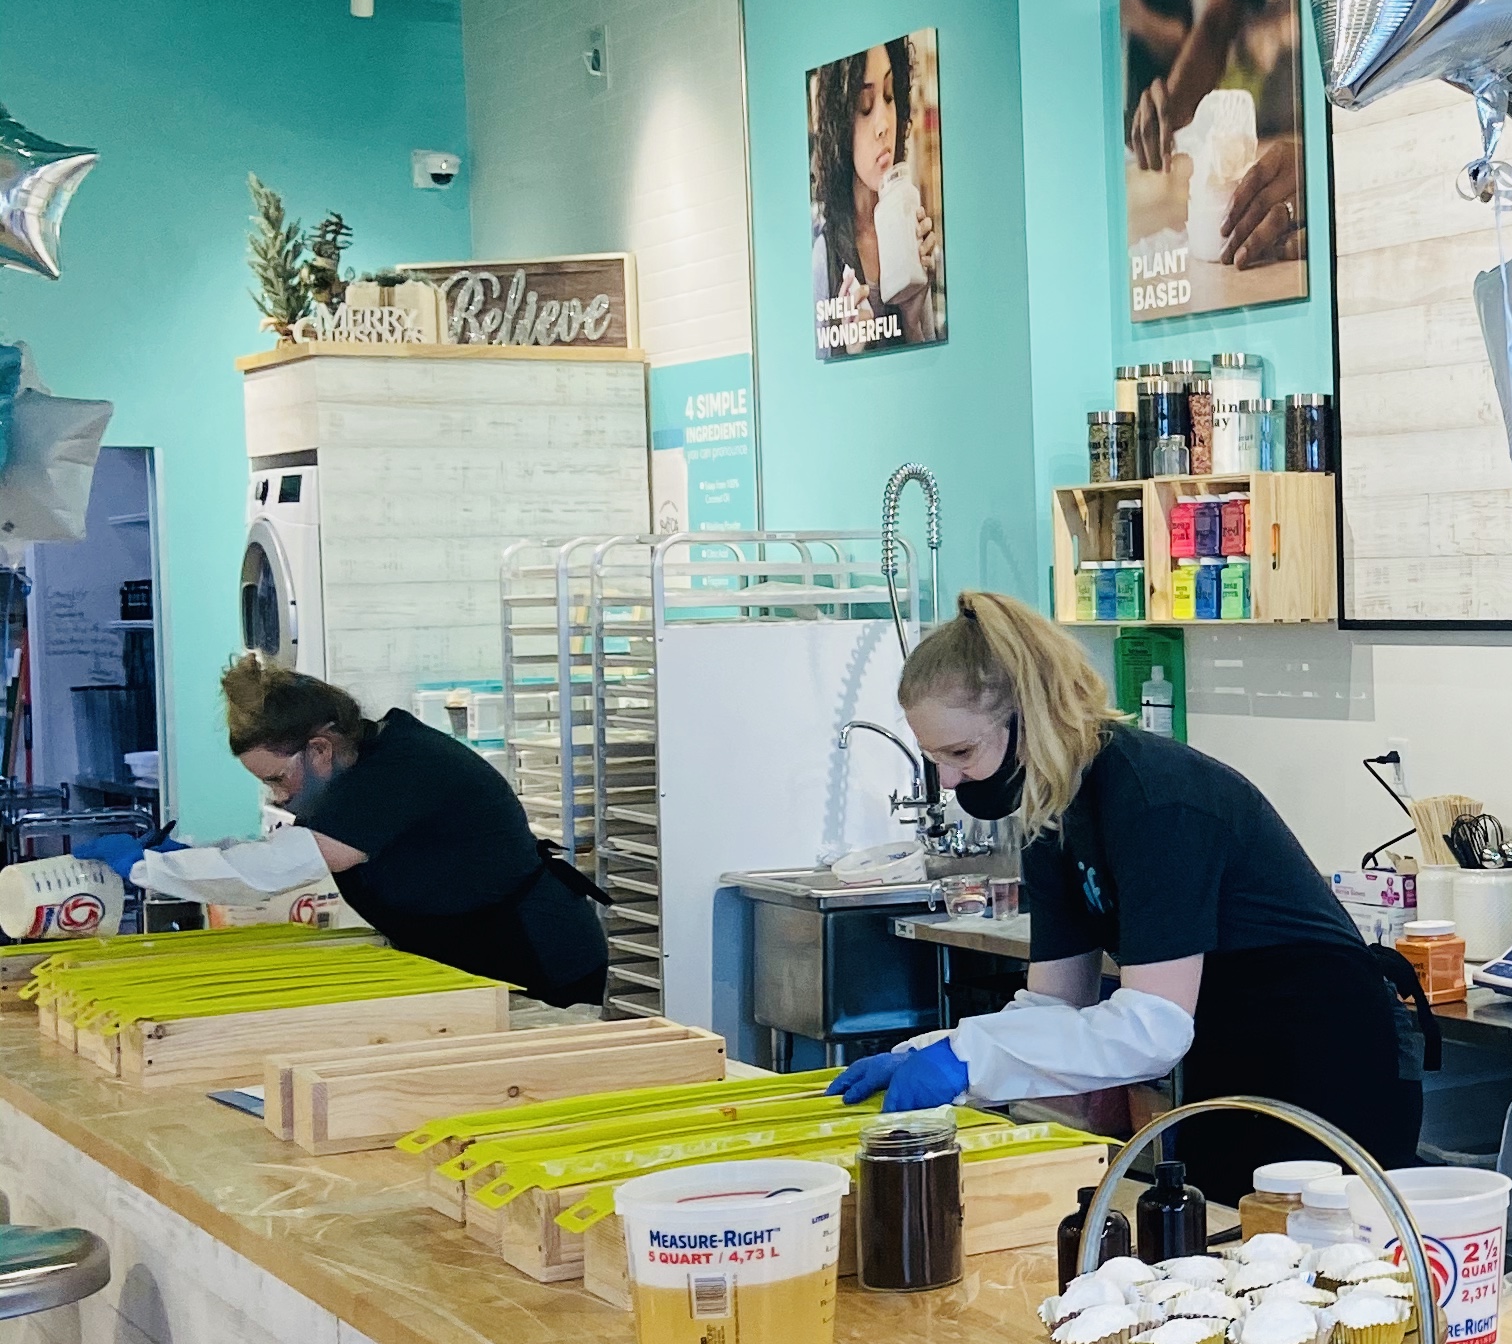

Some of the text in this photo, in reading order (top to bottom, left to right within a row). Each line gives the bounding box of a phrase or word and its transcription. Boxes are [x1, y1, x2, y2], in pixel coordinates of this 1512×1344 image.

[1132, 247, 1188, 280] PLANT
[441, 268, 612, 346] Believe
[816, 295, 858, 321] SMELL
[1133, 279, 1191, 311] BASED
[316, 303, 418, 331] MERRY
[817, 314, 902, 349] WONDERFUL
[685, 388, 747, 420] 4 SIMPLE
[686, 421, 748, 443] INGREDIENTS
[648, 1251, 656, 1263] 5
[659, 1252, 713, 1265] QUART
[728, 1248, 766, 1264] 4,73
[771, 1246, 781, 1258] L
[1461, 1259, 1498, 1279] QUART
[1461, 1286, 1497, 1304] 2,37 L
